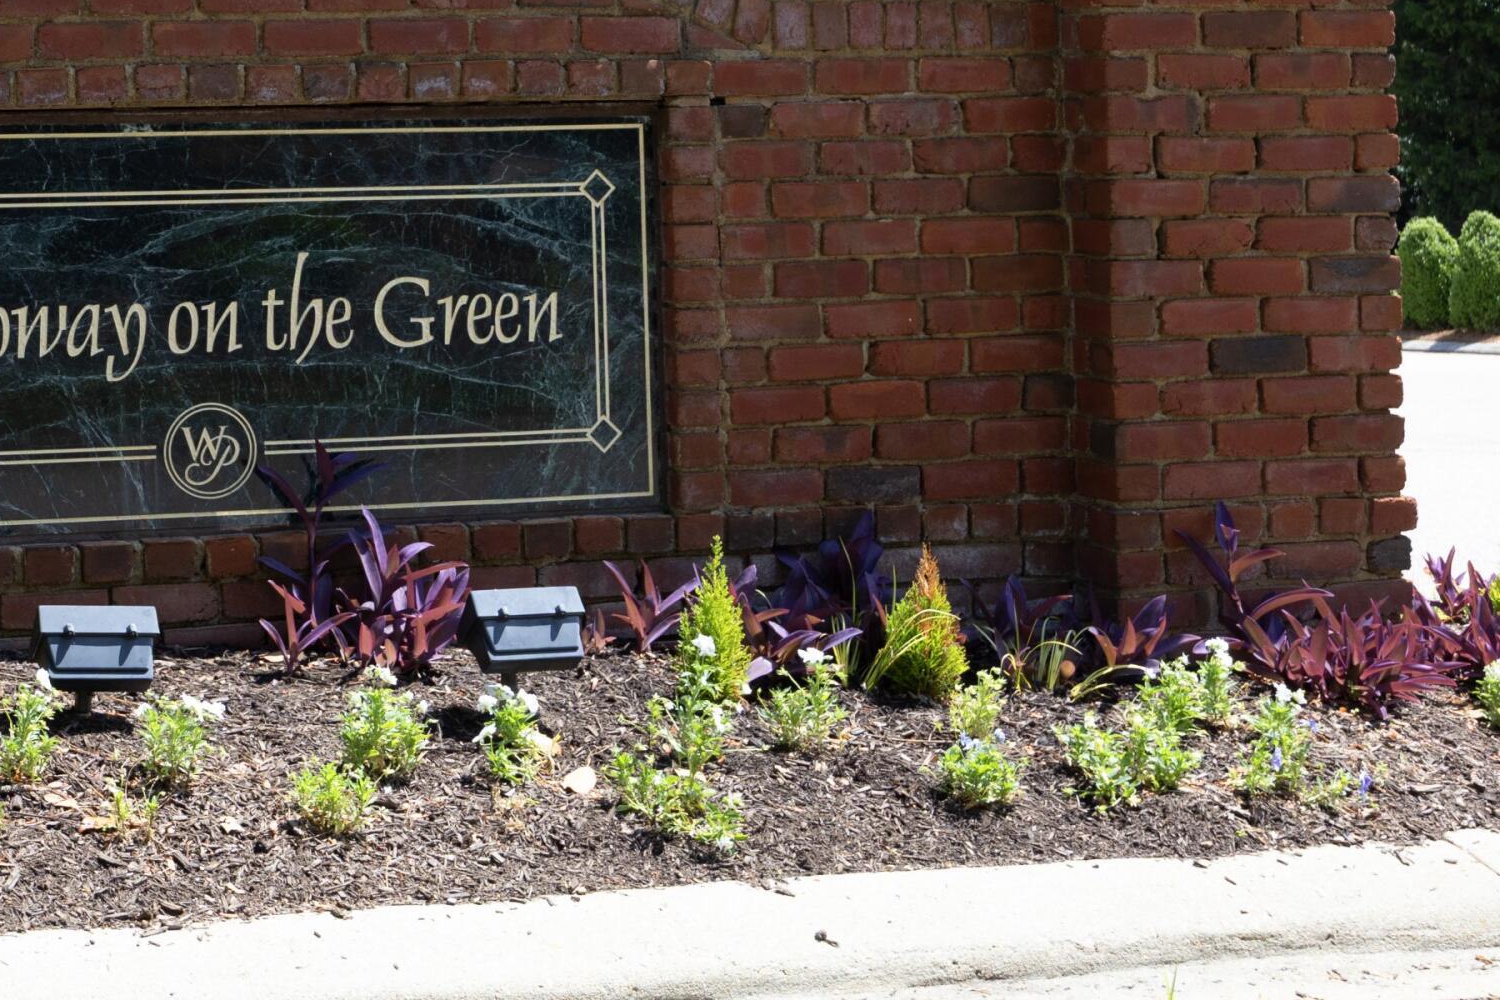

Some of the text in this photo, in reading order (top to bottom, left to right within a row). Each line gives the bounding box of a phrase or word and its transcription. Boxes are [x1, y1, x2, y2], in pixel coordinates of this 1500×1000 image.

[167, 301, 243, 356] on
[264, 252, 353, 368] the
[374, 276, 563, 349] Green
